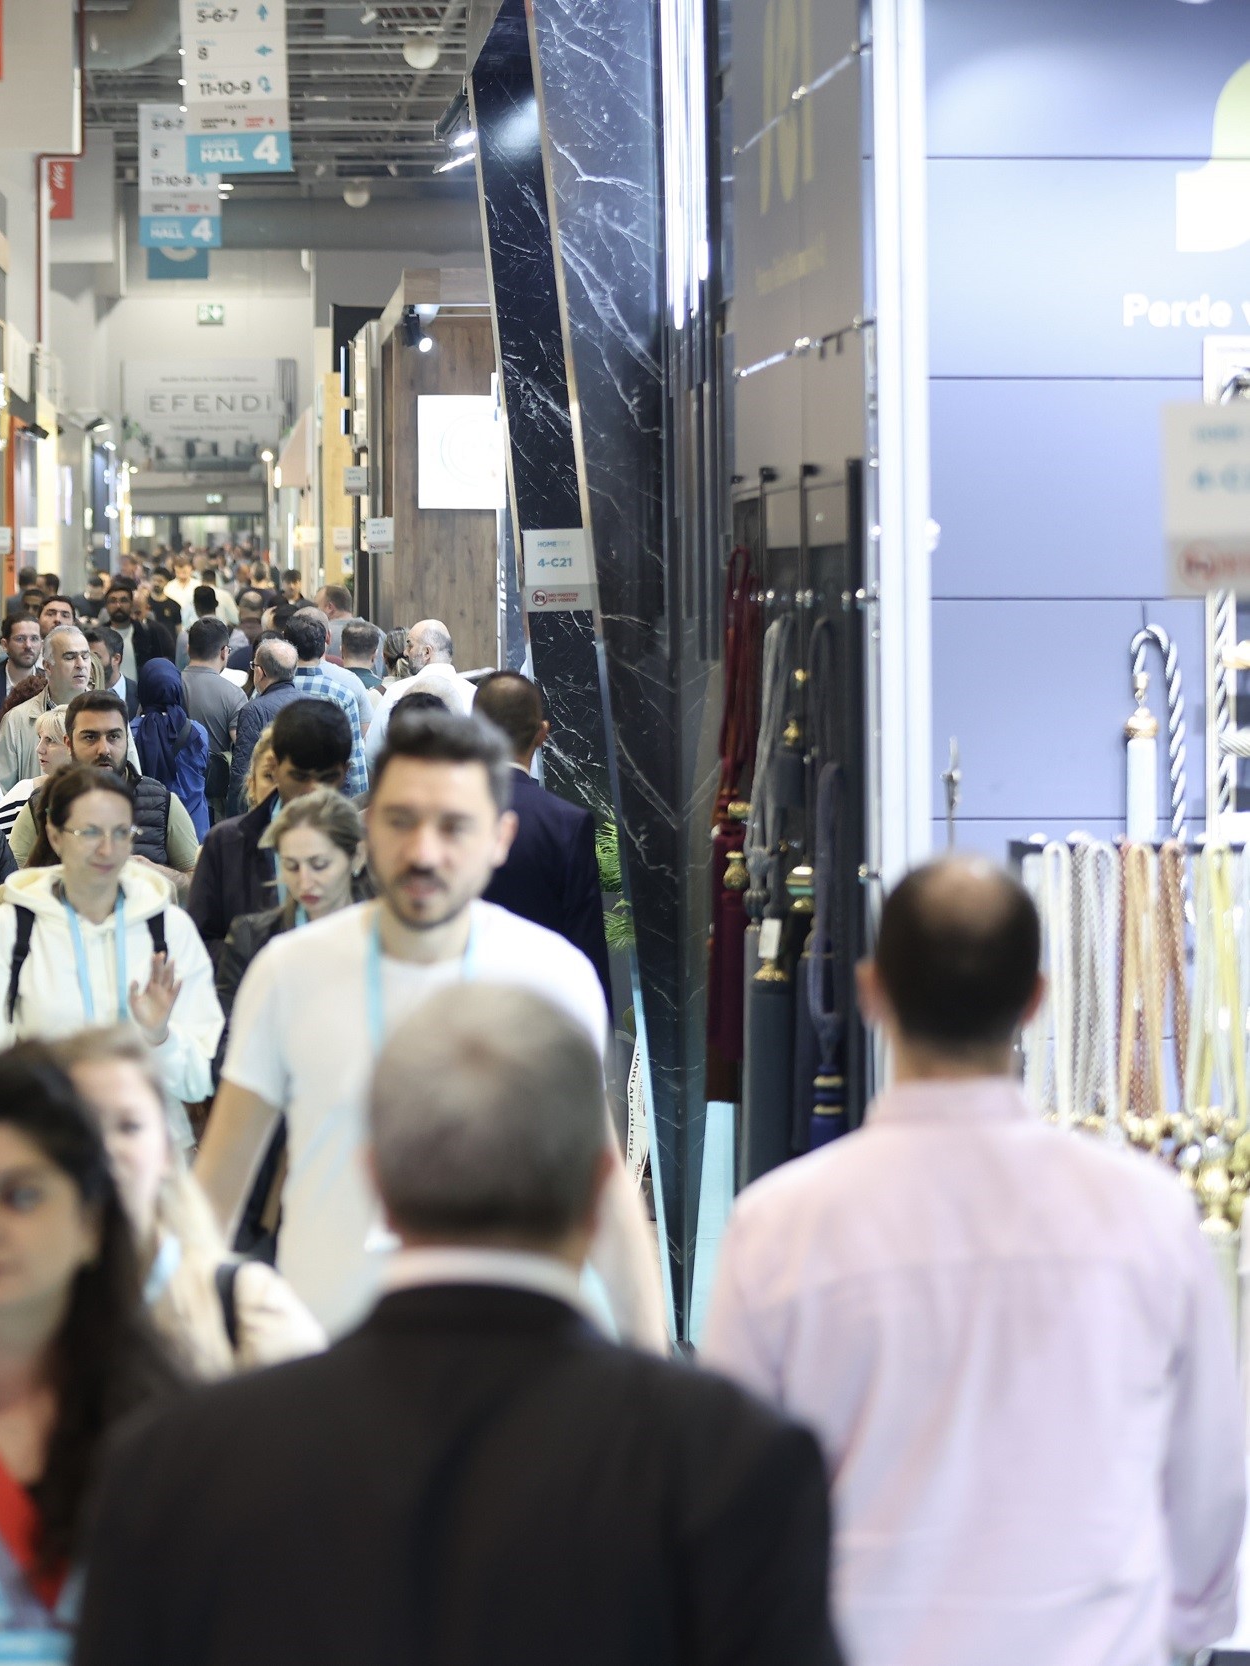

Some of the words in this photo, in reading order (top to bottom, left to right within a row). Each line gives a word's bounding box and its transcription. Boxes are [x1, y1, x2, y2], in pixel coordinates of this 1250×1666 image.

[197, 8, 238, 23] 5-6-7
[198, 47, 208, 60] 8
[199, 81, 251, 96] 11-10-9
[201, 149, 244, 163] HALL
[253, 134, 280, 165] 4
[150, 227, 184, 239] HALL
[191, 218, 213, 242] 4
[149, 394, 271, 413] EFENDI
[537, 557, 573, 567] 4-C21
